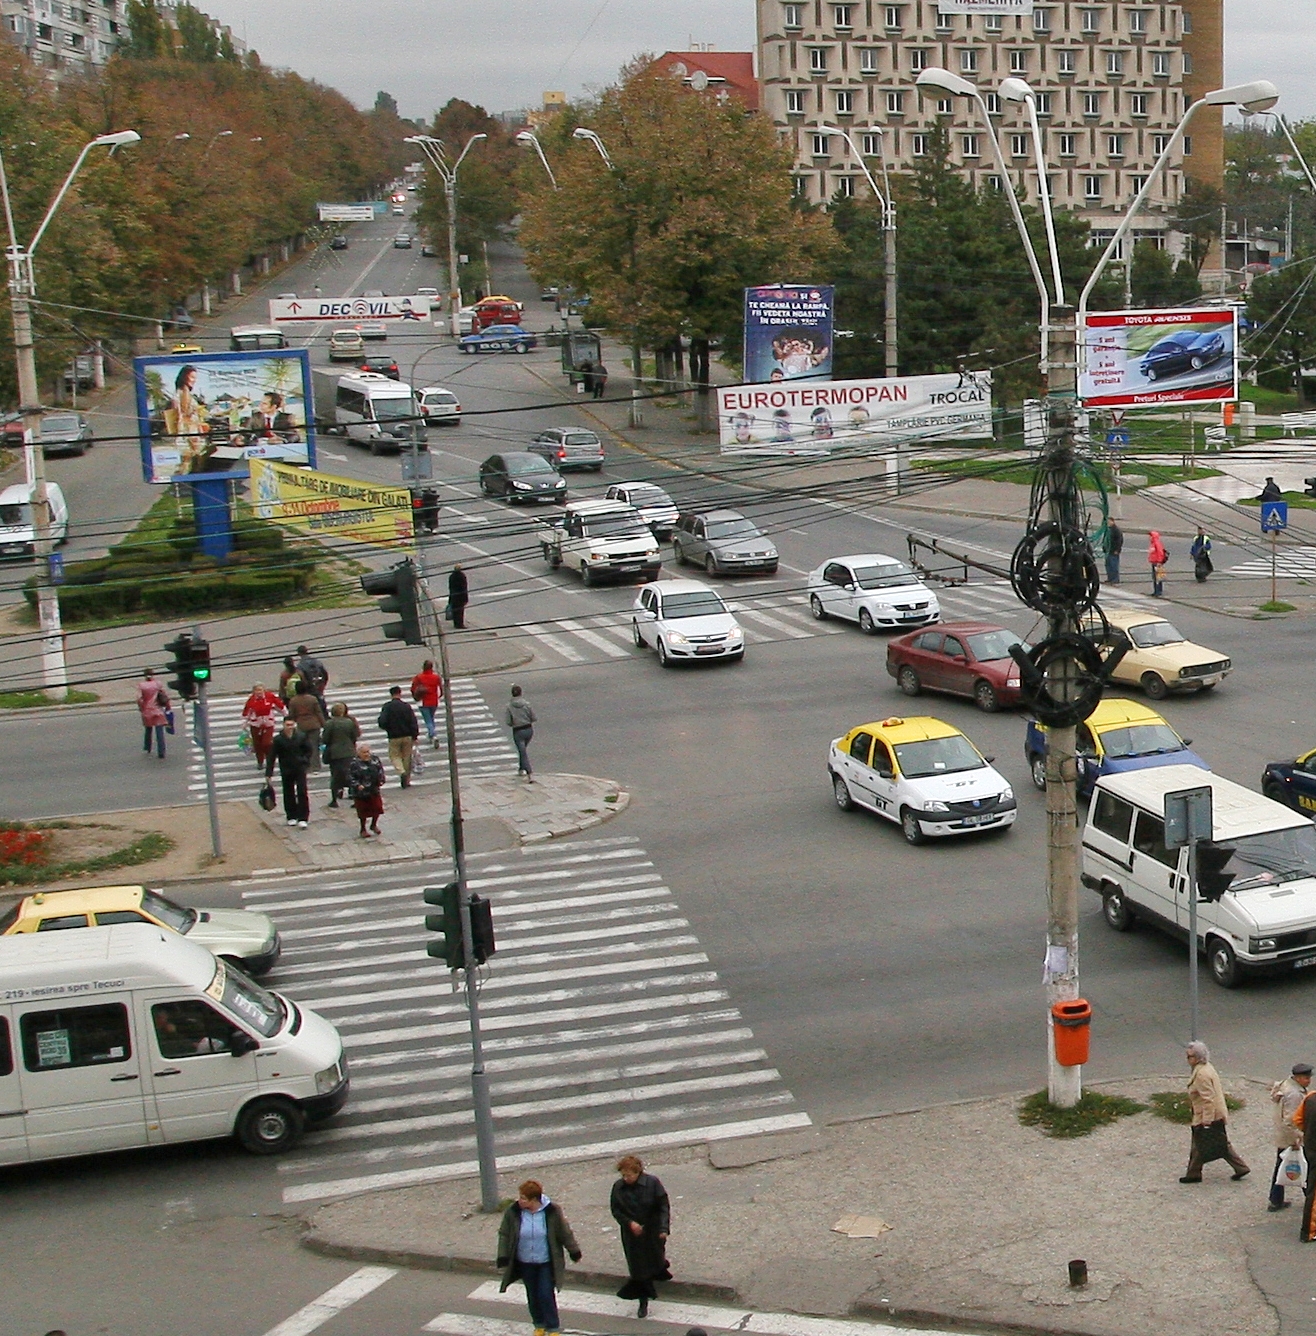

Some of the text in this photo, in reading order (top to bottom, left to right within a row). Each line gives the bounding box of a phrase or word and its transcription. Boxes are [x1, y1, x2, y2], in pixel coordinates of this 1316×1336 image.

[1124, 316, 1152, 324] TOYOTA
[723, 385, 908, 410] EUROTERMOPAN
[929, 389, 985, 405] TROCAL
[319, 480, 329, 493] DE
[368, 490, 381, 505] DIN
[5, 990, 24, 999] 219
[31, 986, 65, 996] iesirea
[67, 984, 89, 993] spre
[93, 980, 124, 989] Tecuci
